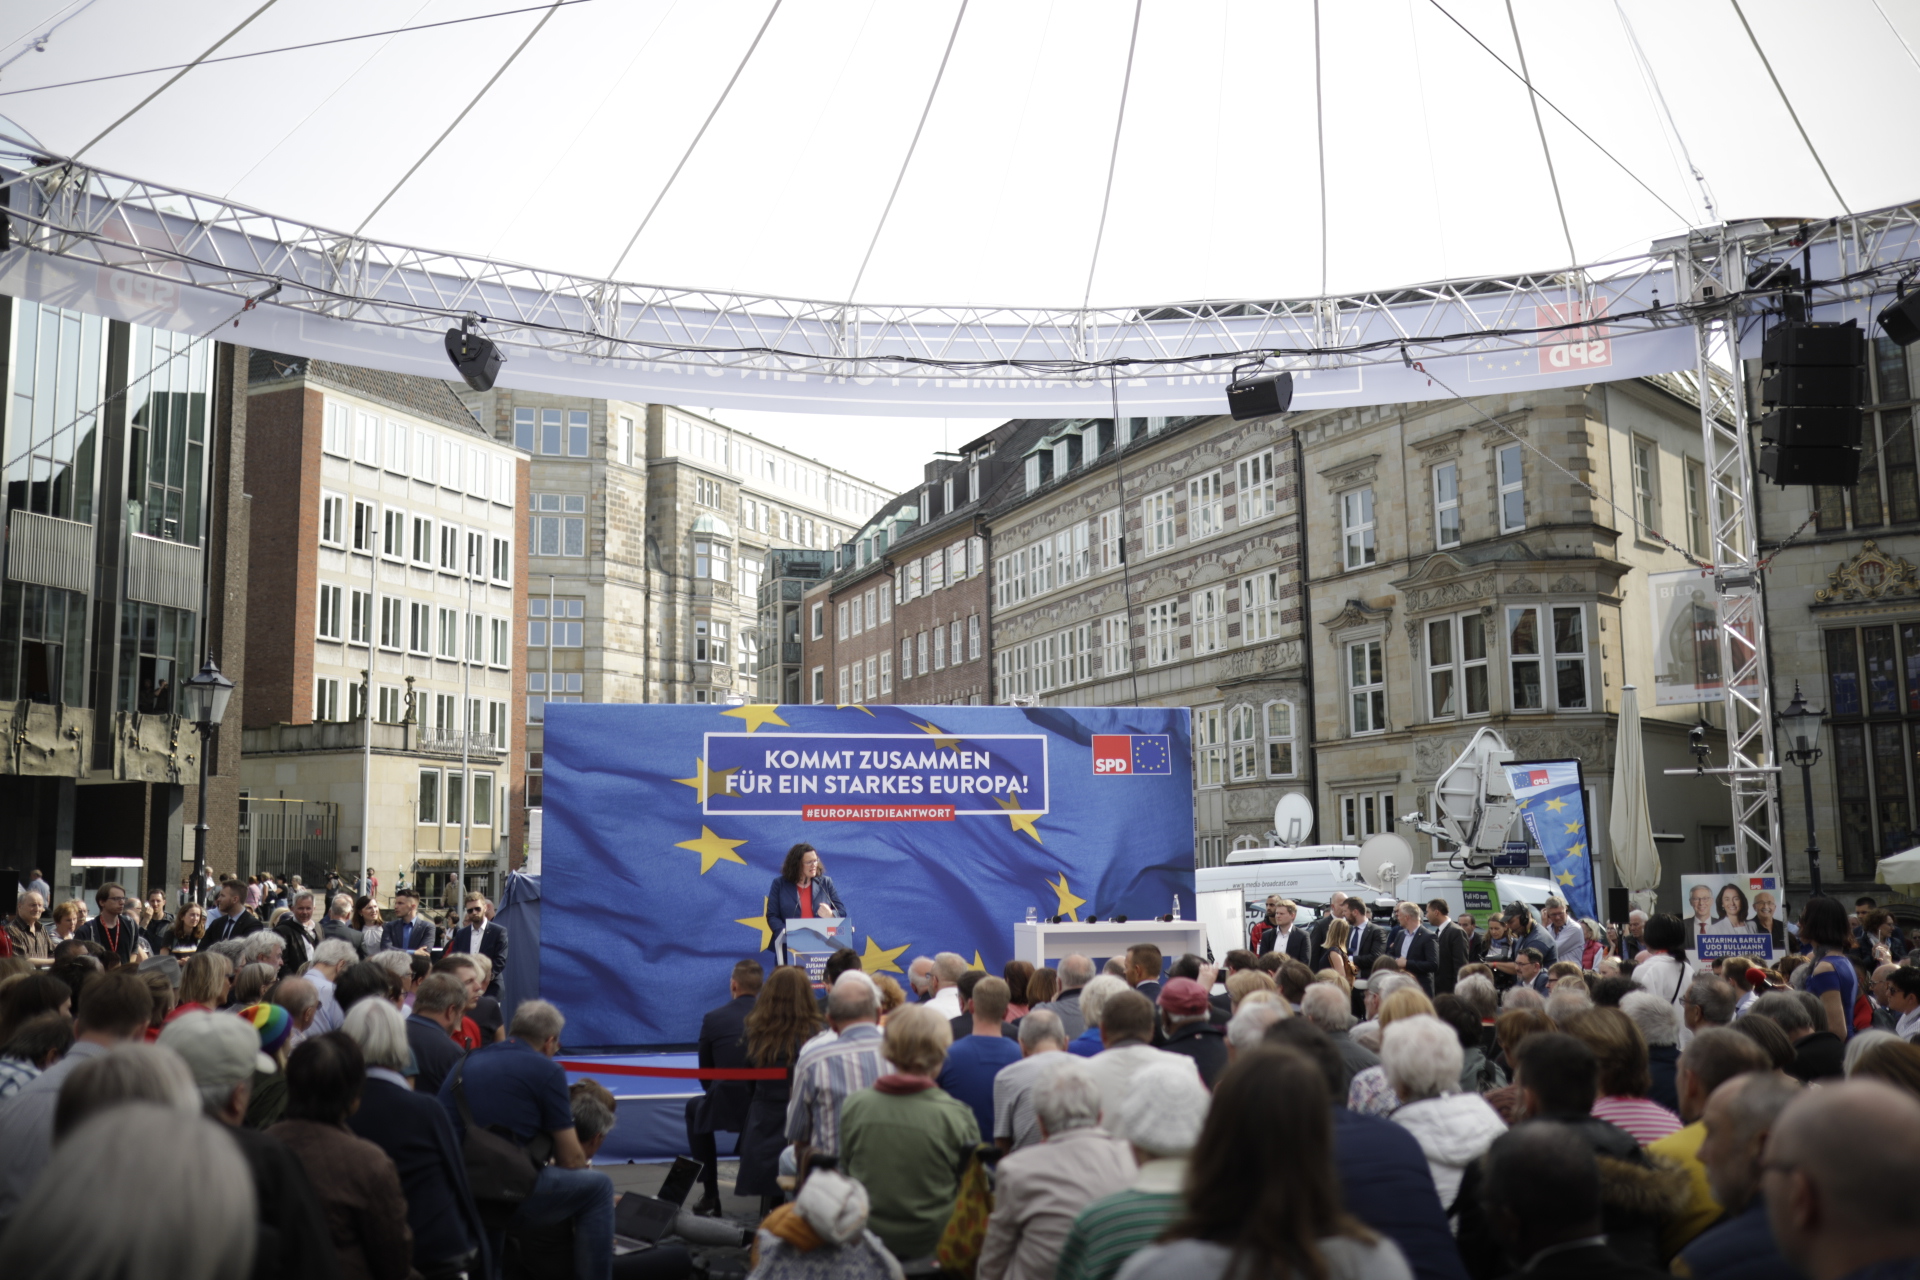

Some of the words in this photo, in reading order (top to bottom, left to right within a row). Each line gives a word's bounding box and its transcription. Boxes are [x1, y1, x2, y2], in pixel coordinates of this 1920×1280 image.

[1660, 584, 1695, 598] BILD
[765, 750, 854, 769] KOMMT
[859, 751, 989, 770] ZUSAMMEN
[1095, 758, 1127, 772] SPD
[725, 770, 772, 793] FÜR
[779, 775, 817, 793] EIN
[824, 775, 924, 794] STARKES
[929, 775, 1028, 794] EUROPA!
[806, 809, 951, 819] #EUROPAISTDIEANTWORT
[417, 858, 468, 868] STARBUCS
